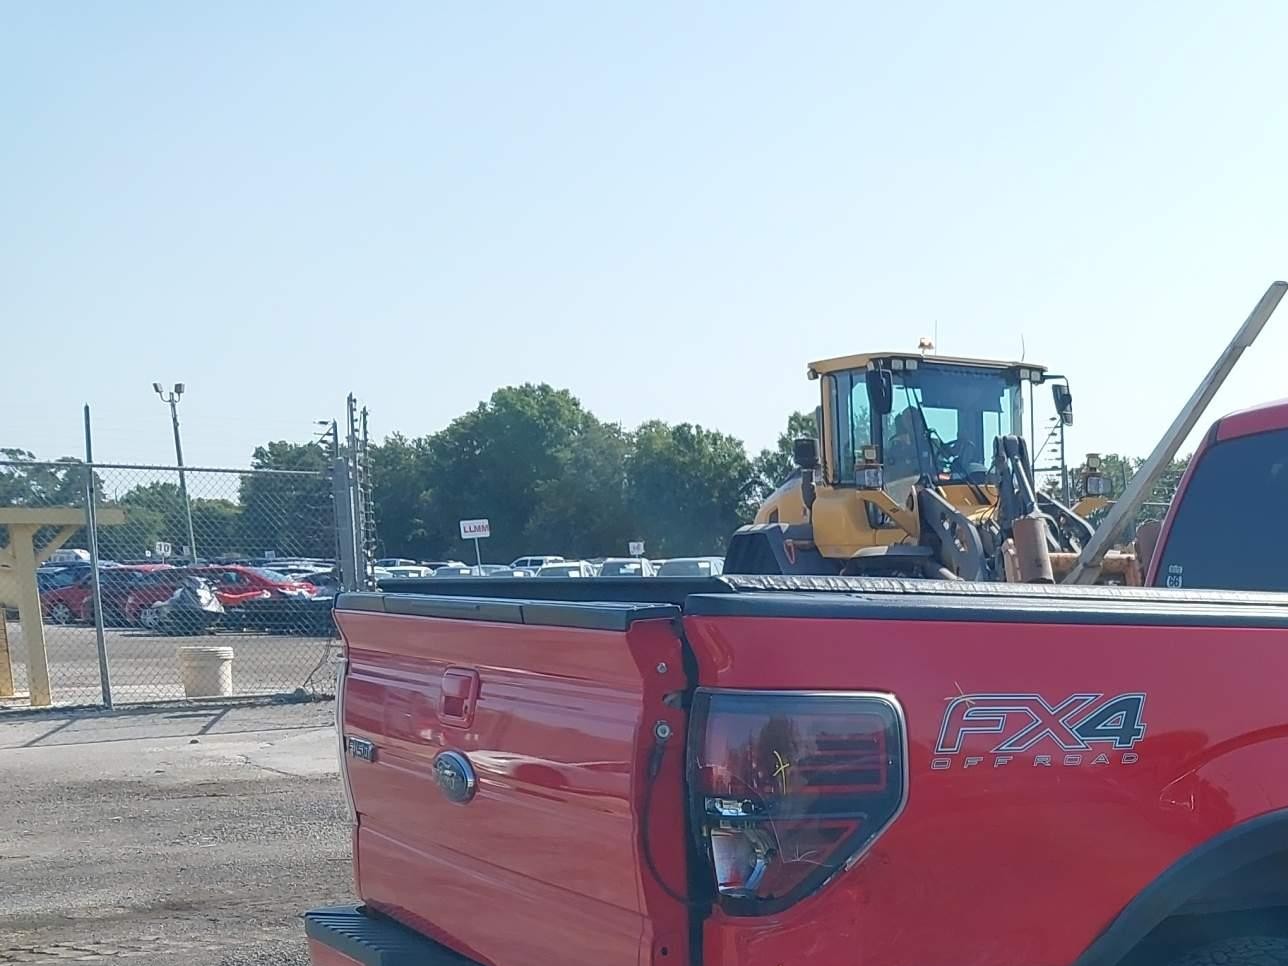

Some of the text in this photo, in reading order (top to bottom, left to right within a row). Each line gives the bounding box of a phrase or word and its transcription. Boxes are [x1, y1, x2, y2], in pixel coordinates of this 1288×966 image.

[934, 693, 1147, 754] FX4
[931, 752, 1139, 769] OFF ROAD
